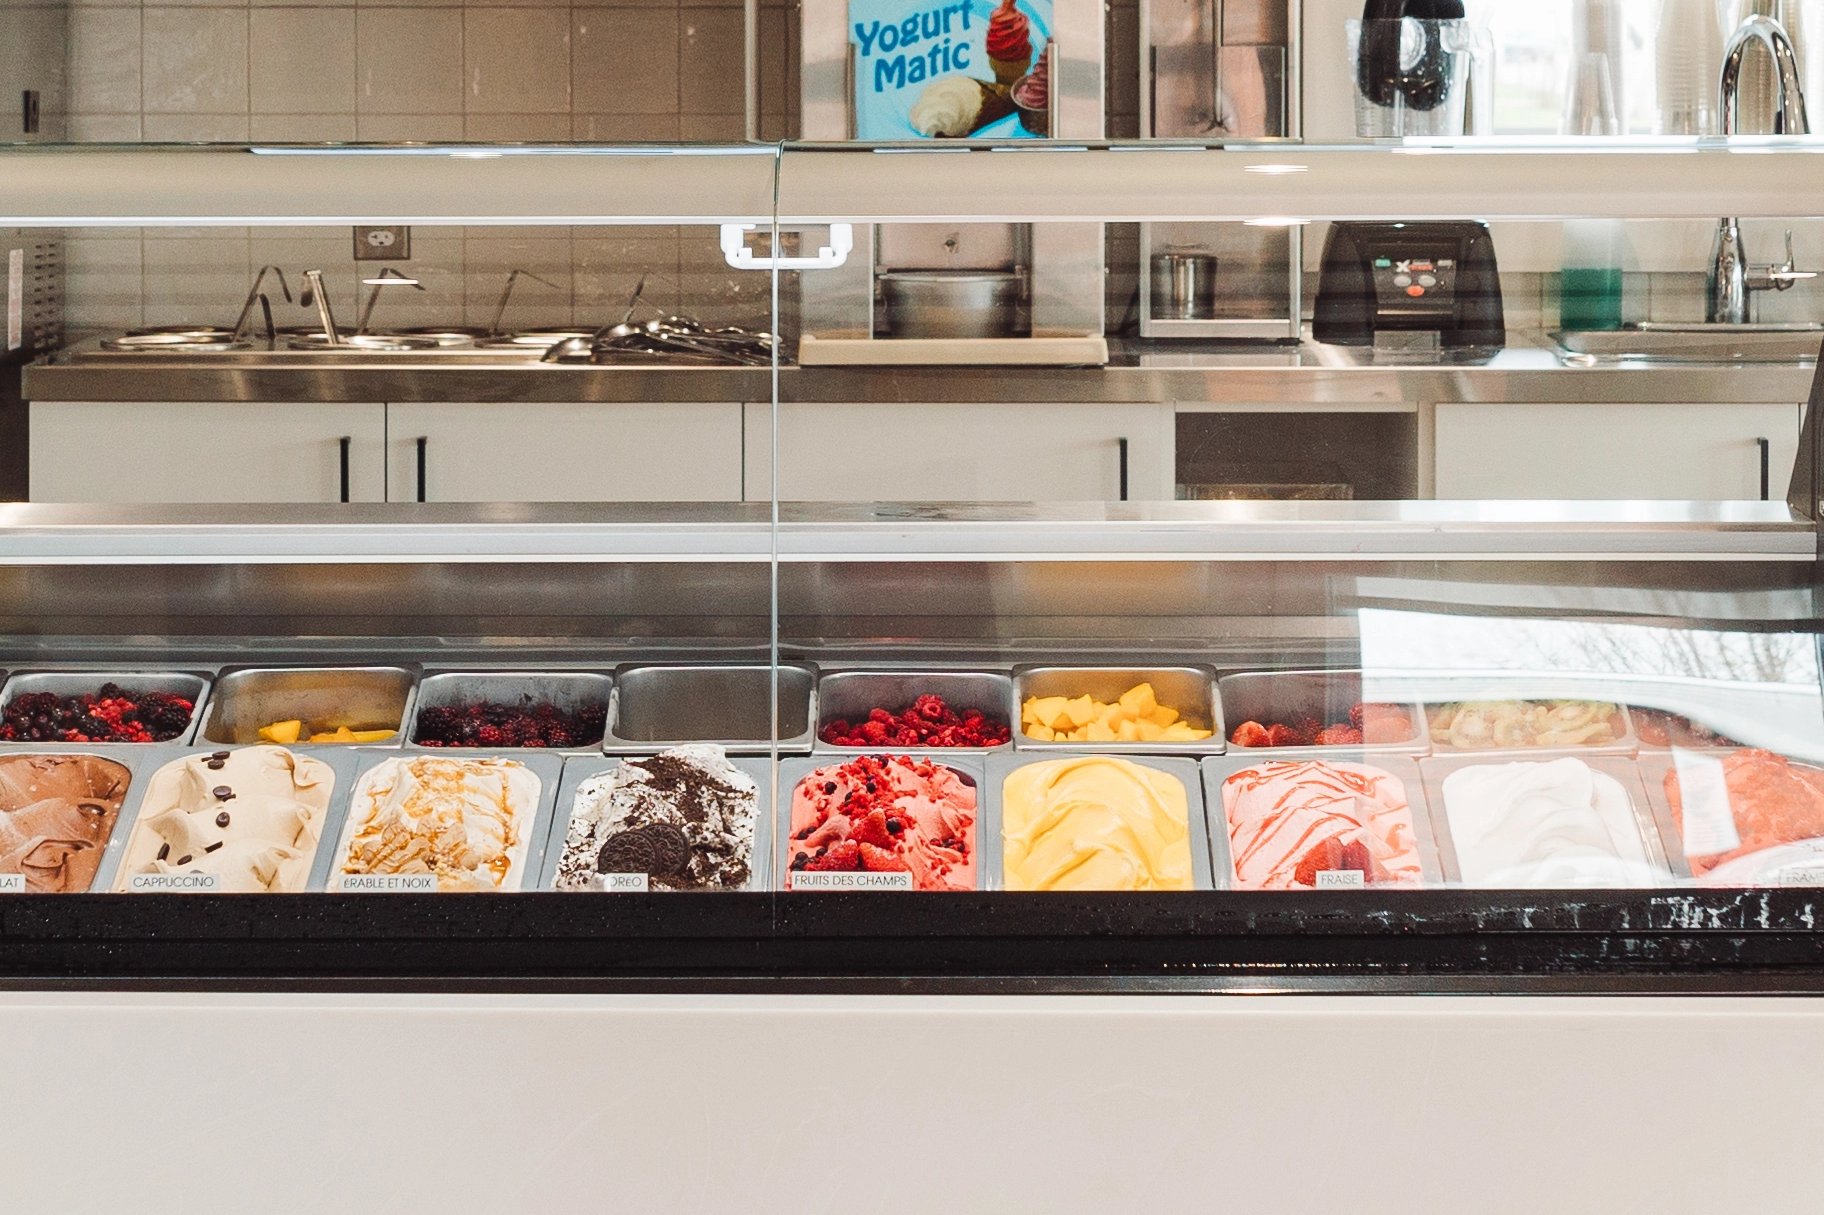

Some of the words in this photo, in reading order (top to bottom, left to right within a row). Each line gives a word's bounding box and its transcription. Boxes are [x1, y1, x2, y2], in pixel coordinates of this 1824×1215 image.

[873, 39, 971, 93] Matic
[133, 877, 214, 887] CAPPUCCINO
[344, 878, 384, 888] ÉRABLE
[388, 878, 398, 888] ET
[403, 878, 431, 888] NOIX
[795, 875, 829, 885] FRUITS
[833, 875, 853, 885] DES
[857, 875, 907, 886] CHAMPS
[1322, 875, 1358, 884] FRAISE
